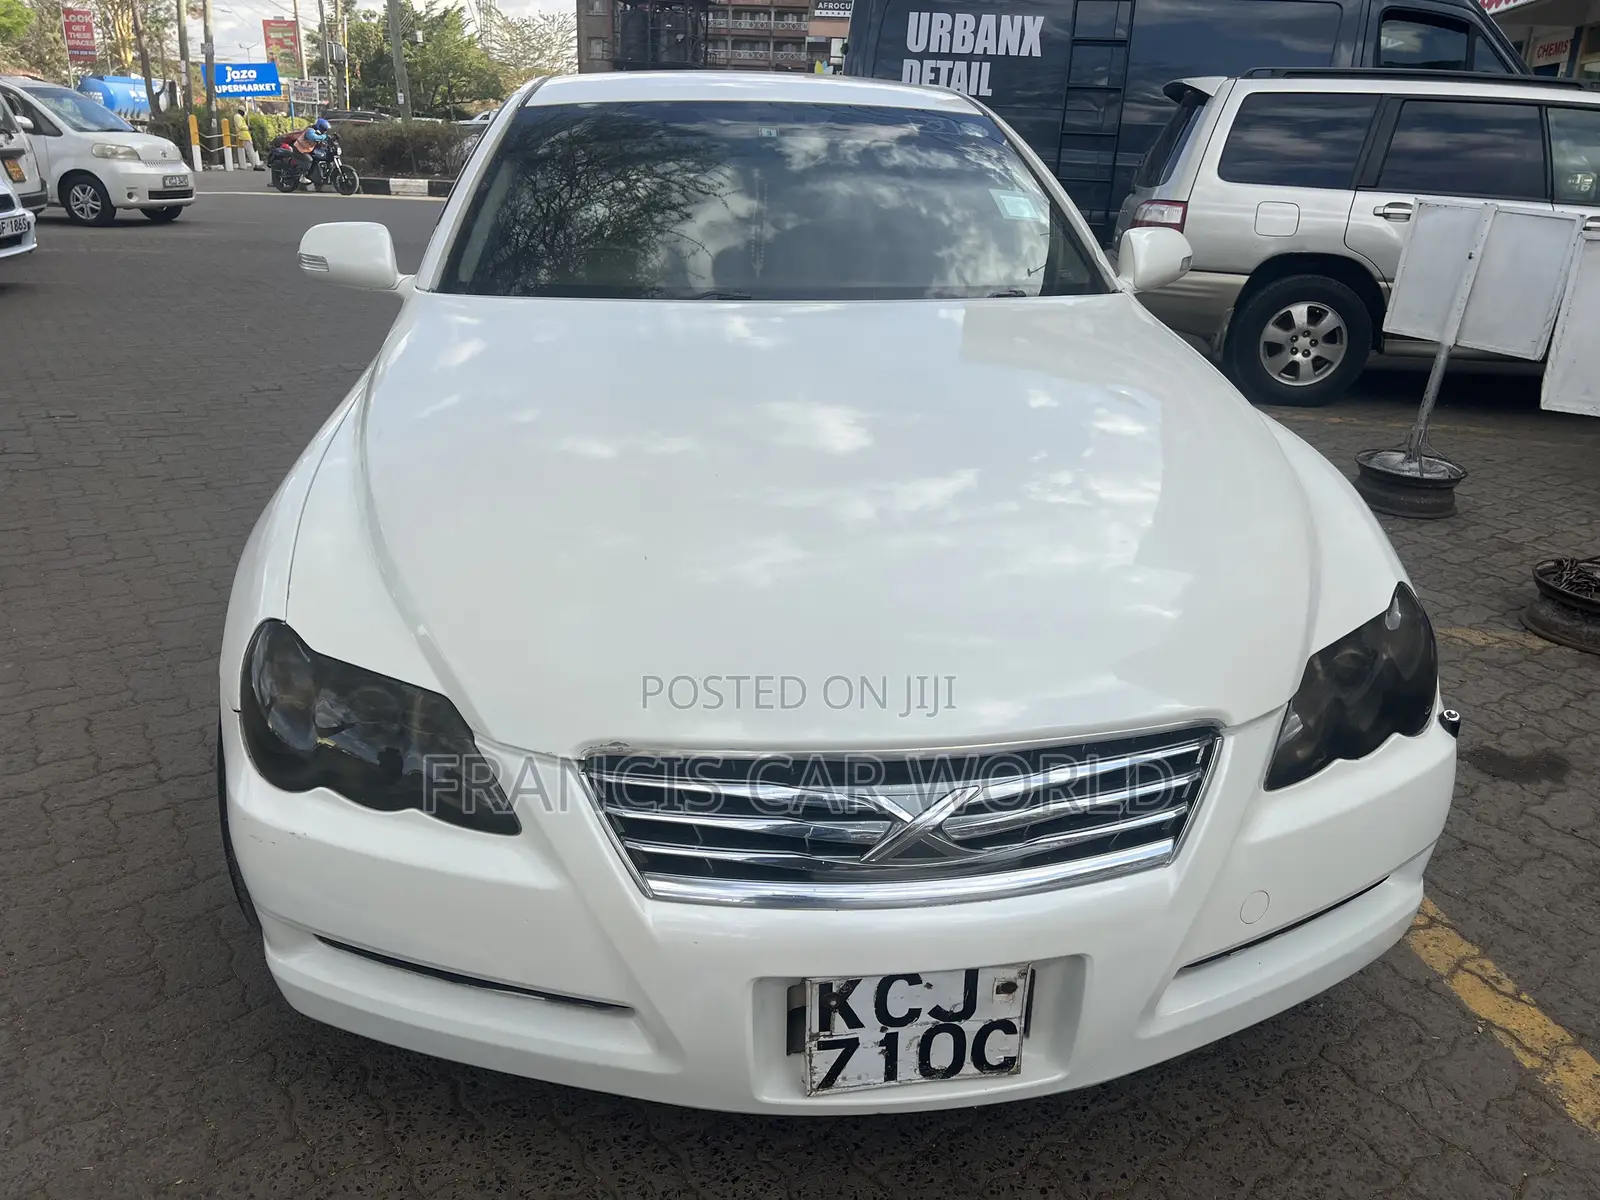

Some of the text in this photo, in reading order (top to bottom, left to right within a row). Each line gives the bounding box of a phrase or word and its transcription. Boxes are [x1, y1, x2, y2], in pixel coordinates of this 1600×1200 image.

[817, 2, 851, 10] AFROCU
[906, 12, 1045, 57] URBANX
[214, 83, 277, 94] UPERMARKET
[901, 59, 993, 96] DETAIL
[818, 968, 980, 1033] KCJ
[815, 1018, 1018, 1090] 710C
